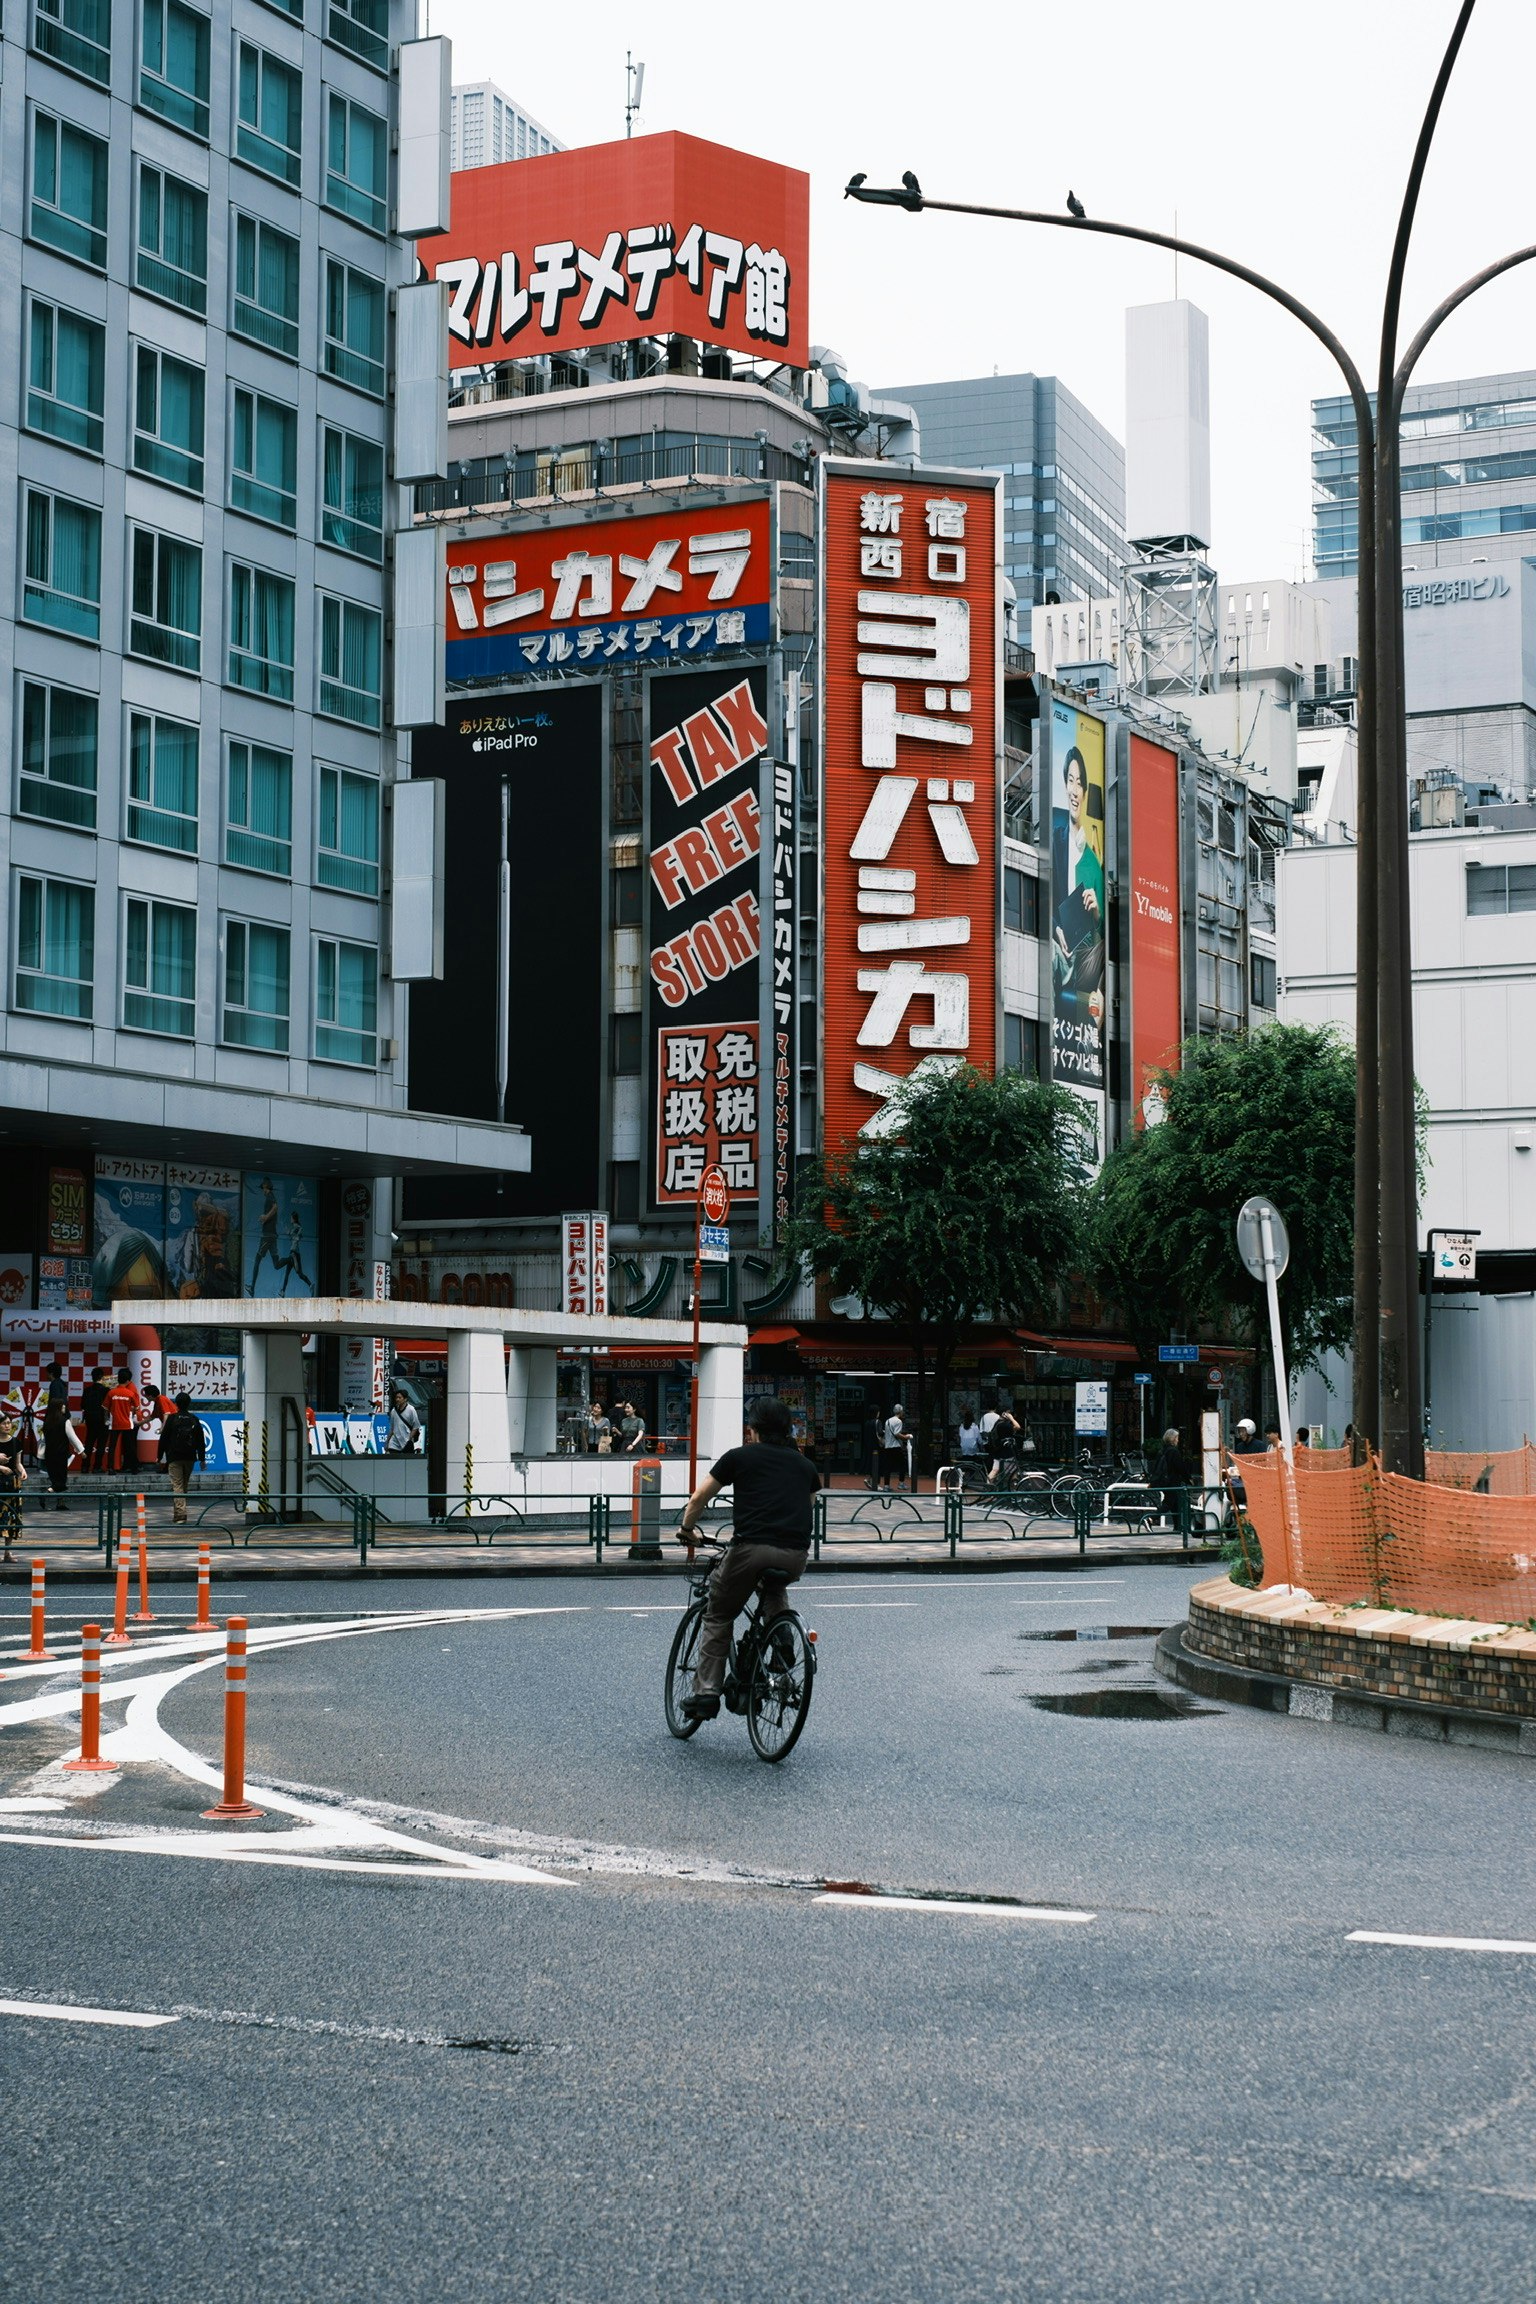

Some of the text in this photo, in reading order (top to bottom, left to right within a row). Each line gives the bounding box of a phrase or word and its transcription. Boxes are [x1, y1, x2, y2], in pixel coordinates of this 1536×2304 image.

[1402, 575, 1511, 609] 宿昭和ビル
[518, 610, 746, 664] マルチメディア館
[459, 711, 554, 735] ありえない一枚。
[483, 733, 538, 752] iPad Pro
[650, 678, 768, 808] TAX
[849, 590, 980, 1158] ヨドバシカメ
[774, 766, 794, 1025] ヨドバシカメラ
[664, 1036, 709, 1191] 取扱店
[715, 1033, 758, 1189] 免税品
[51, 1182, 85, 1208] SIM
[56, 1208, 80, 1221] カード
[168, 1359, 236, 1377] 登山・アウトドア
[1210, 1371, 1220, 1380] 20
[168, 1379, 237, 1396] キャンプ・スキー
